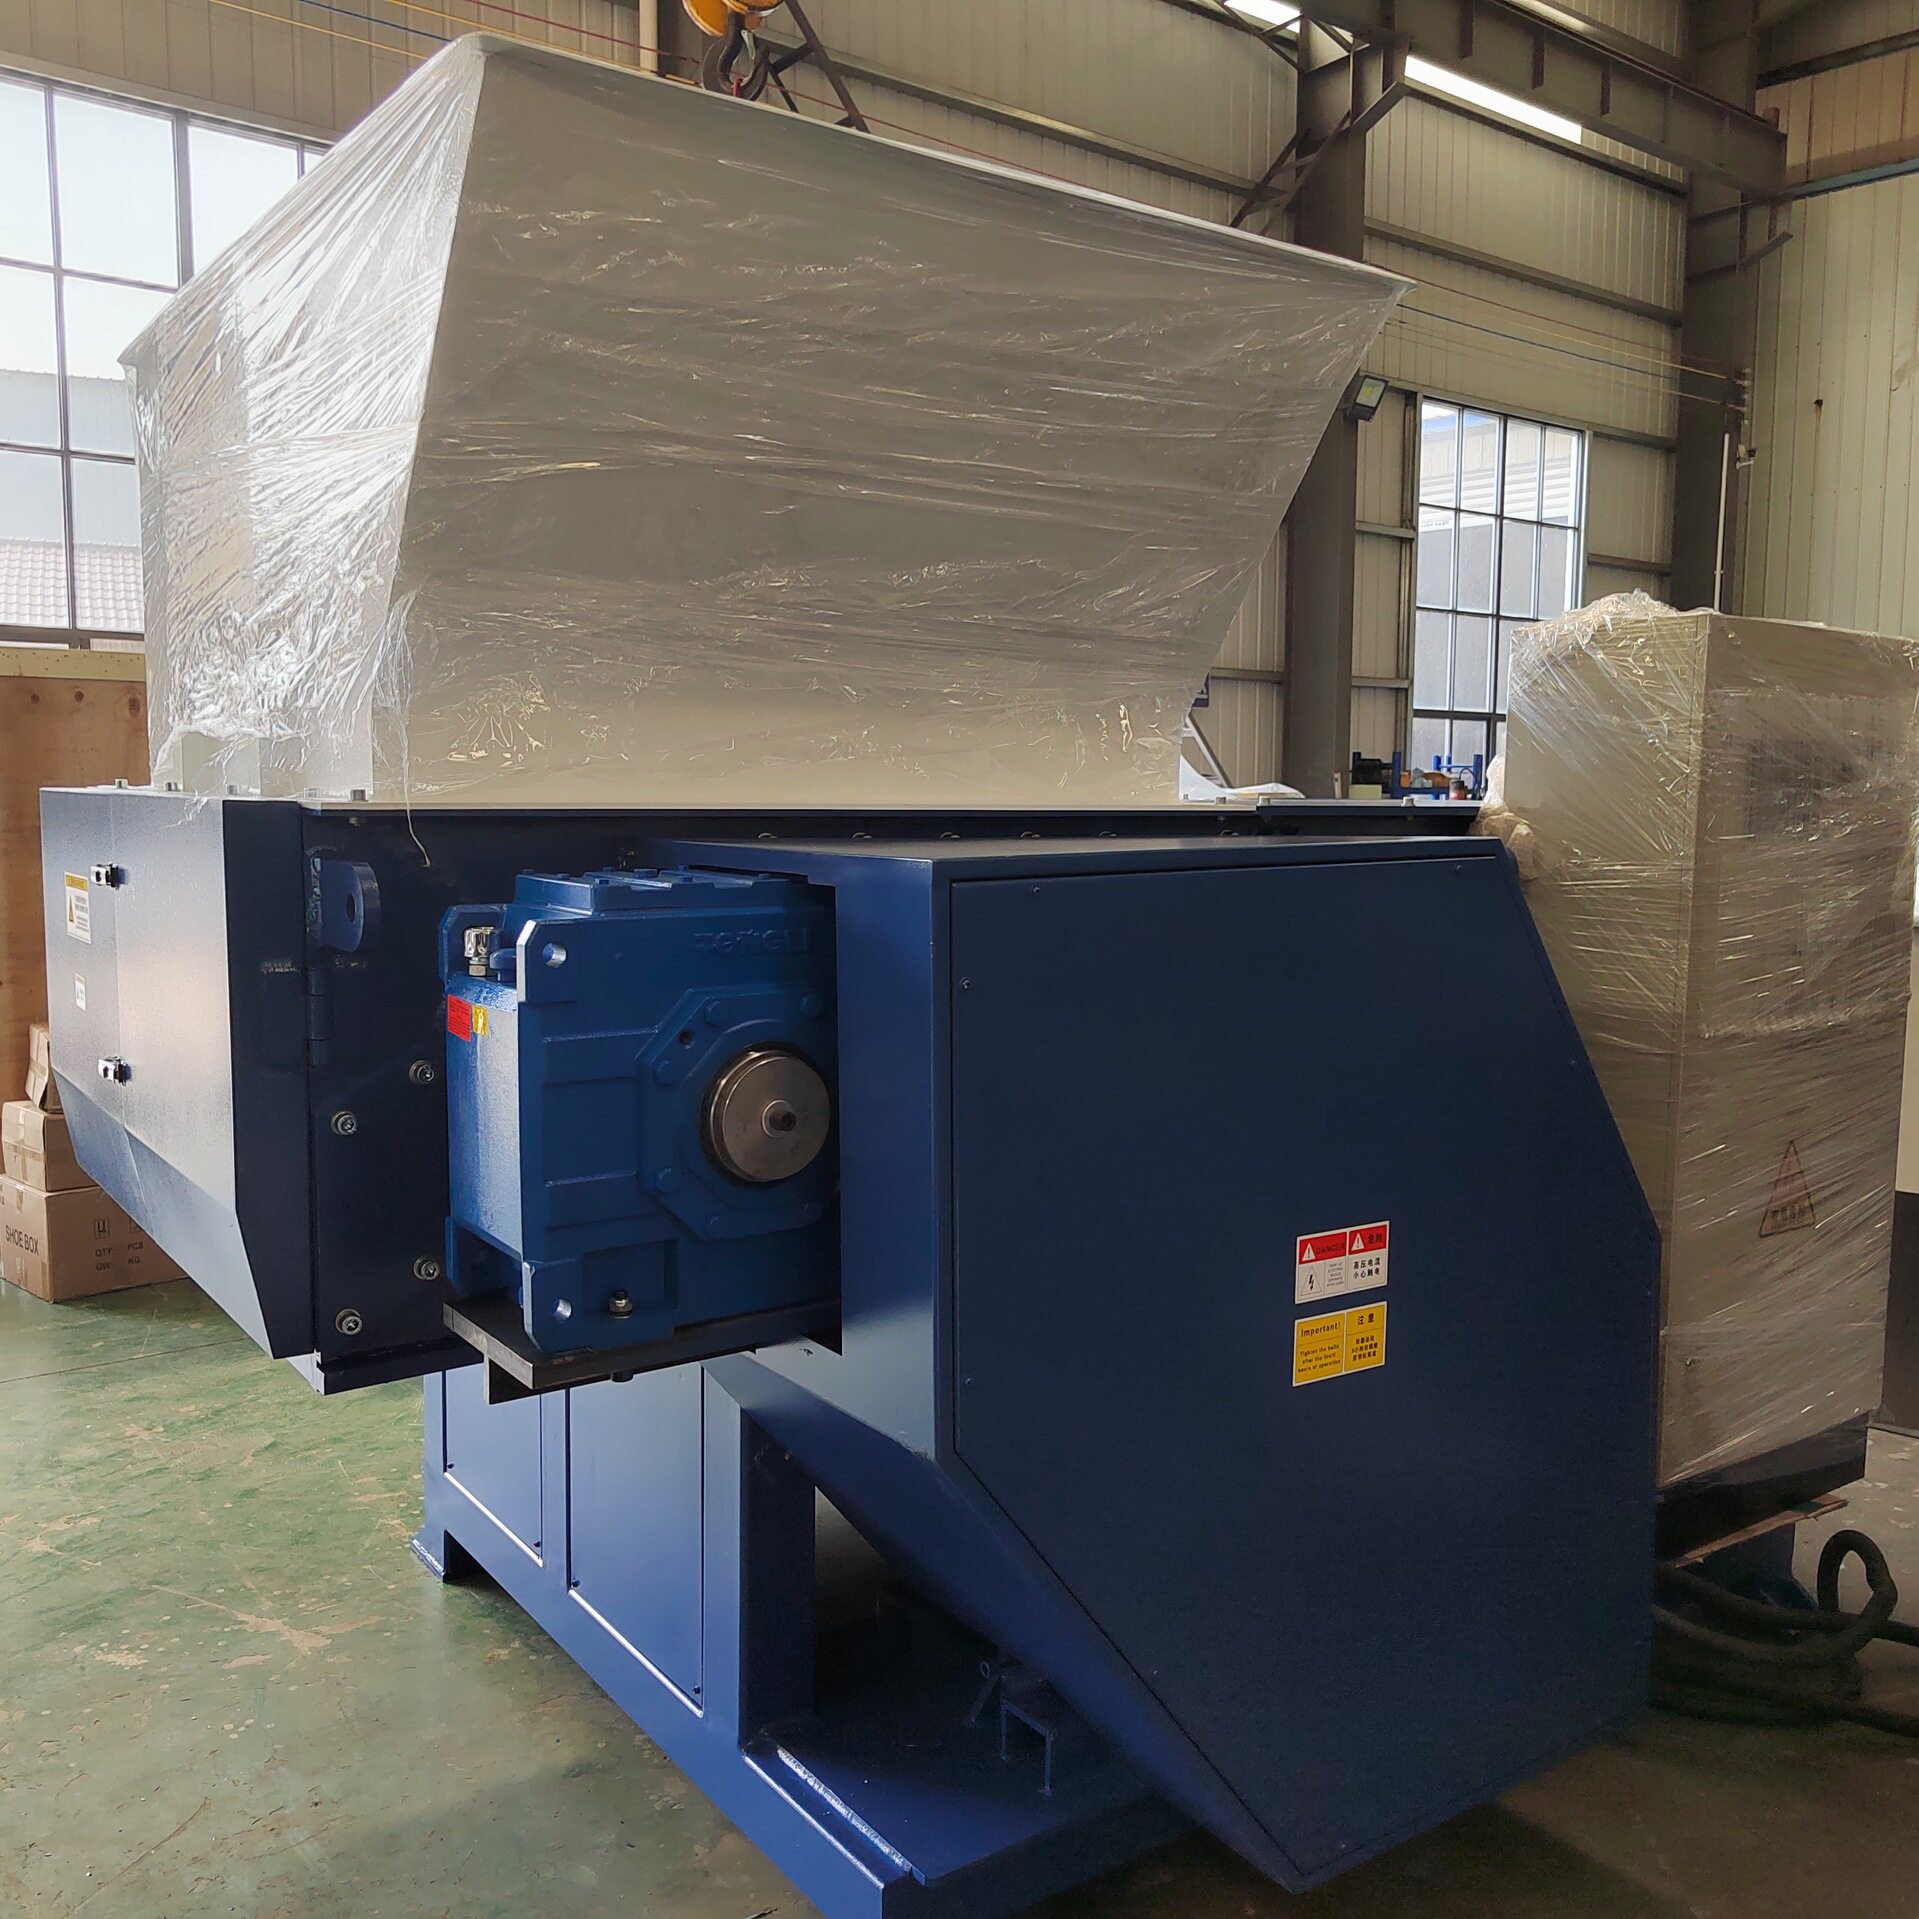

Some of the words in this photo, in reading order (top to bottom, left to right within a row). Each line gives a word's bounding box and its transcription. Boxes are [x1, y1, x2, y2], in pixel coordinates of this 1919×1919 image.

[5, 1225, 24, 1248] SHOE
[24, 1234, 40, 1256] BOX
[1316, 1242, 1345, 1255] DANGER
[1357, 1312, 1375, 1325] 注意
[1300, 1321, 1341, 1337] Important!
